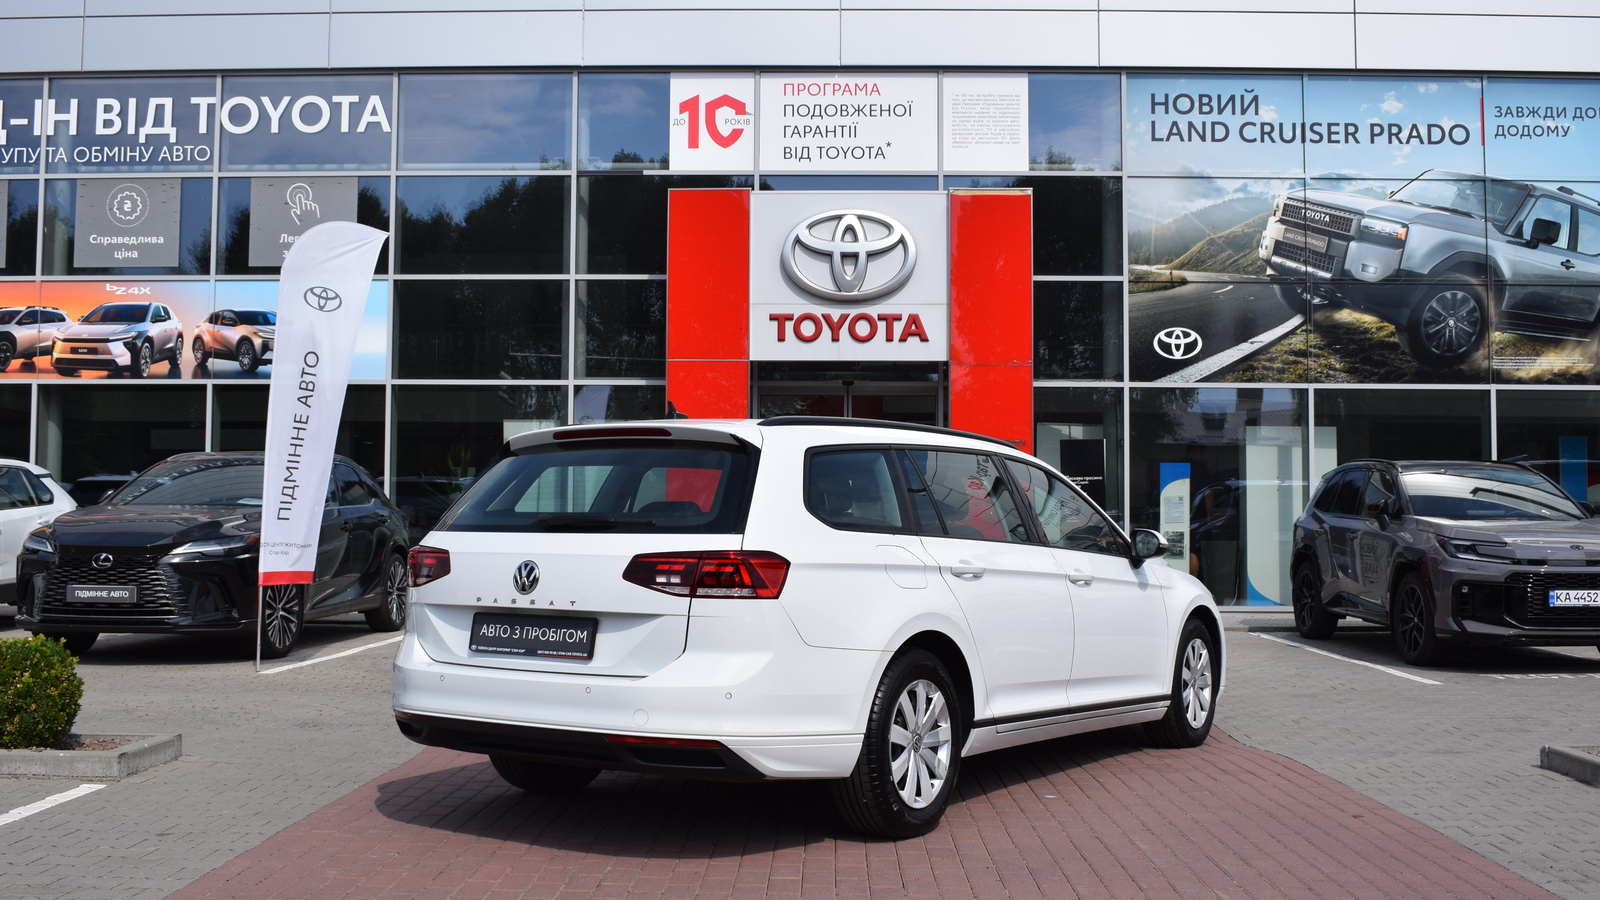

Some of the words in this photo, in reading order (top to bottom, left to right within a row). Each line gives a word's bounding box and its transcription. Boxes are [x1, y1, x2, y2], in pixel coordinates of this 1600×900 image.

[783, 82, 882, 97] ПРОГРАМА
[1150, 87, 1260, 116] НОВИЙ
[783, 100, 913, 120] ПОДОВЖЕНОЇ
[1494, 106, 1567, 121] ЗАВЖДИ
[1572, 106, 1600, 122] ДО
[0, 98, 79, 146] -ІН
[96, 97, 177, 144] ВІД
[190, 94, 392, 135] TOYOTA
[672, 118, 686, 127] ДО
[724, 118, 751, 126] РОКІВ
[783, 122, 858, 139] ГАРАНТІЇ
[1150, 121, 1230, 143] LAND
[1238, 120, 1362, 145] CRUISER
[1369, 123, 1472, 146] PRADO
[1494, 124, 1571, 140] ДОДОМУ
[46, 146, 68, 163] ТА
[74, 146, 154, 163] ОБМІНУ
[158, 145, 211, 162] АВТО
[783, 146, 812, 162] ВІД
[1302, 209, 1330, 222] TOYOTA
[90, 234, 164, 246] Справедлива
[280, 234, 299, 243] Лег
[114, 249, 138, 260] ціна
[769, 312, 930, 342] TOYOTA
[277, 413, 310, 521] ПІДМІННЕ
[296, 351, 320, 408] АВТО
[75, 590, 108, 598] ПІДМІННЕ
[476, 597, 576, 606] PASSAT
[1555, 592, 1572, 602] KA
[1574, 592, 1599, 602] 4452
[480, 624, 510, 638] АВТО
[512, 626, 520, 639] З
[522, 626, 588, 643] ПРОБІГОМ
